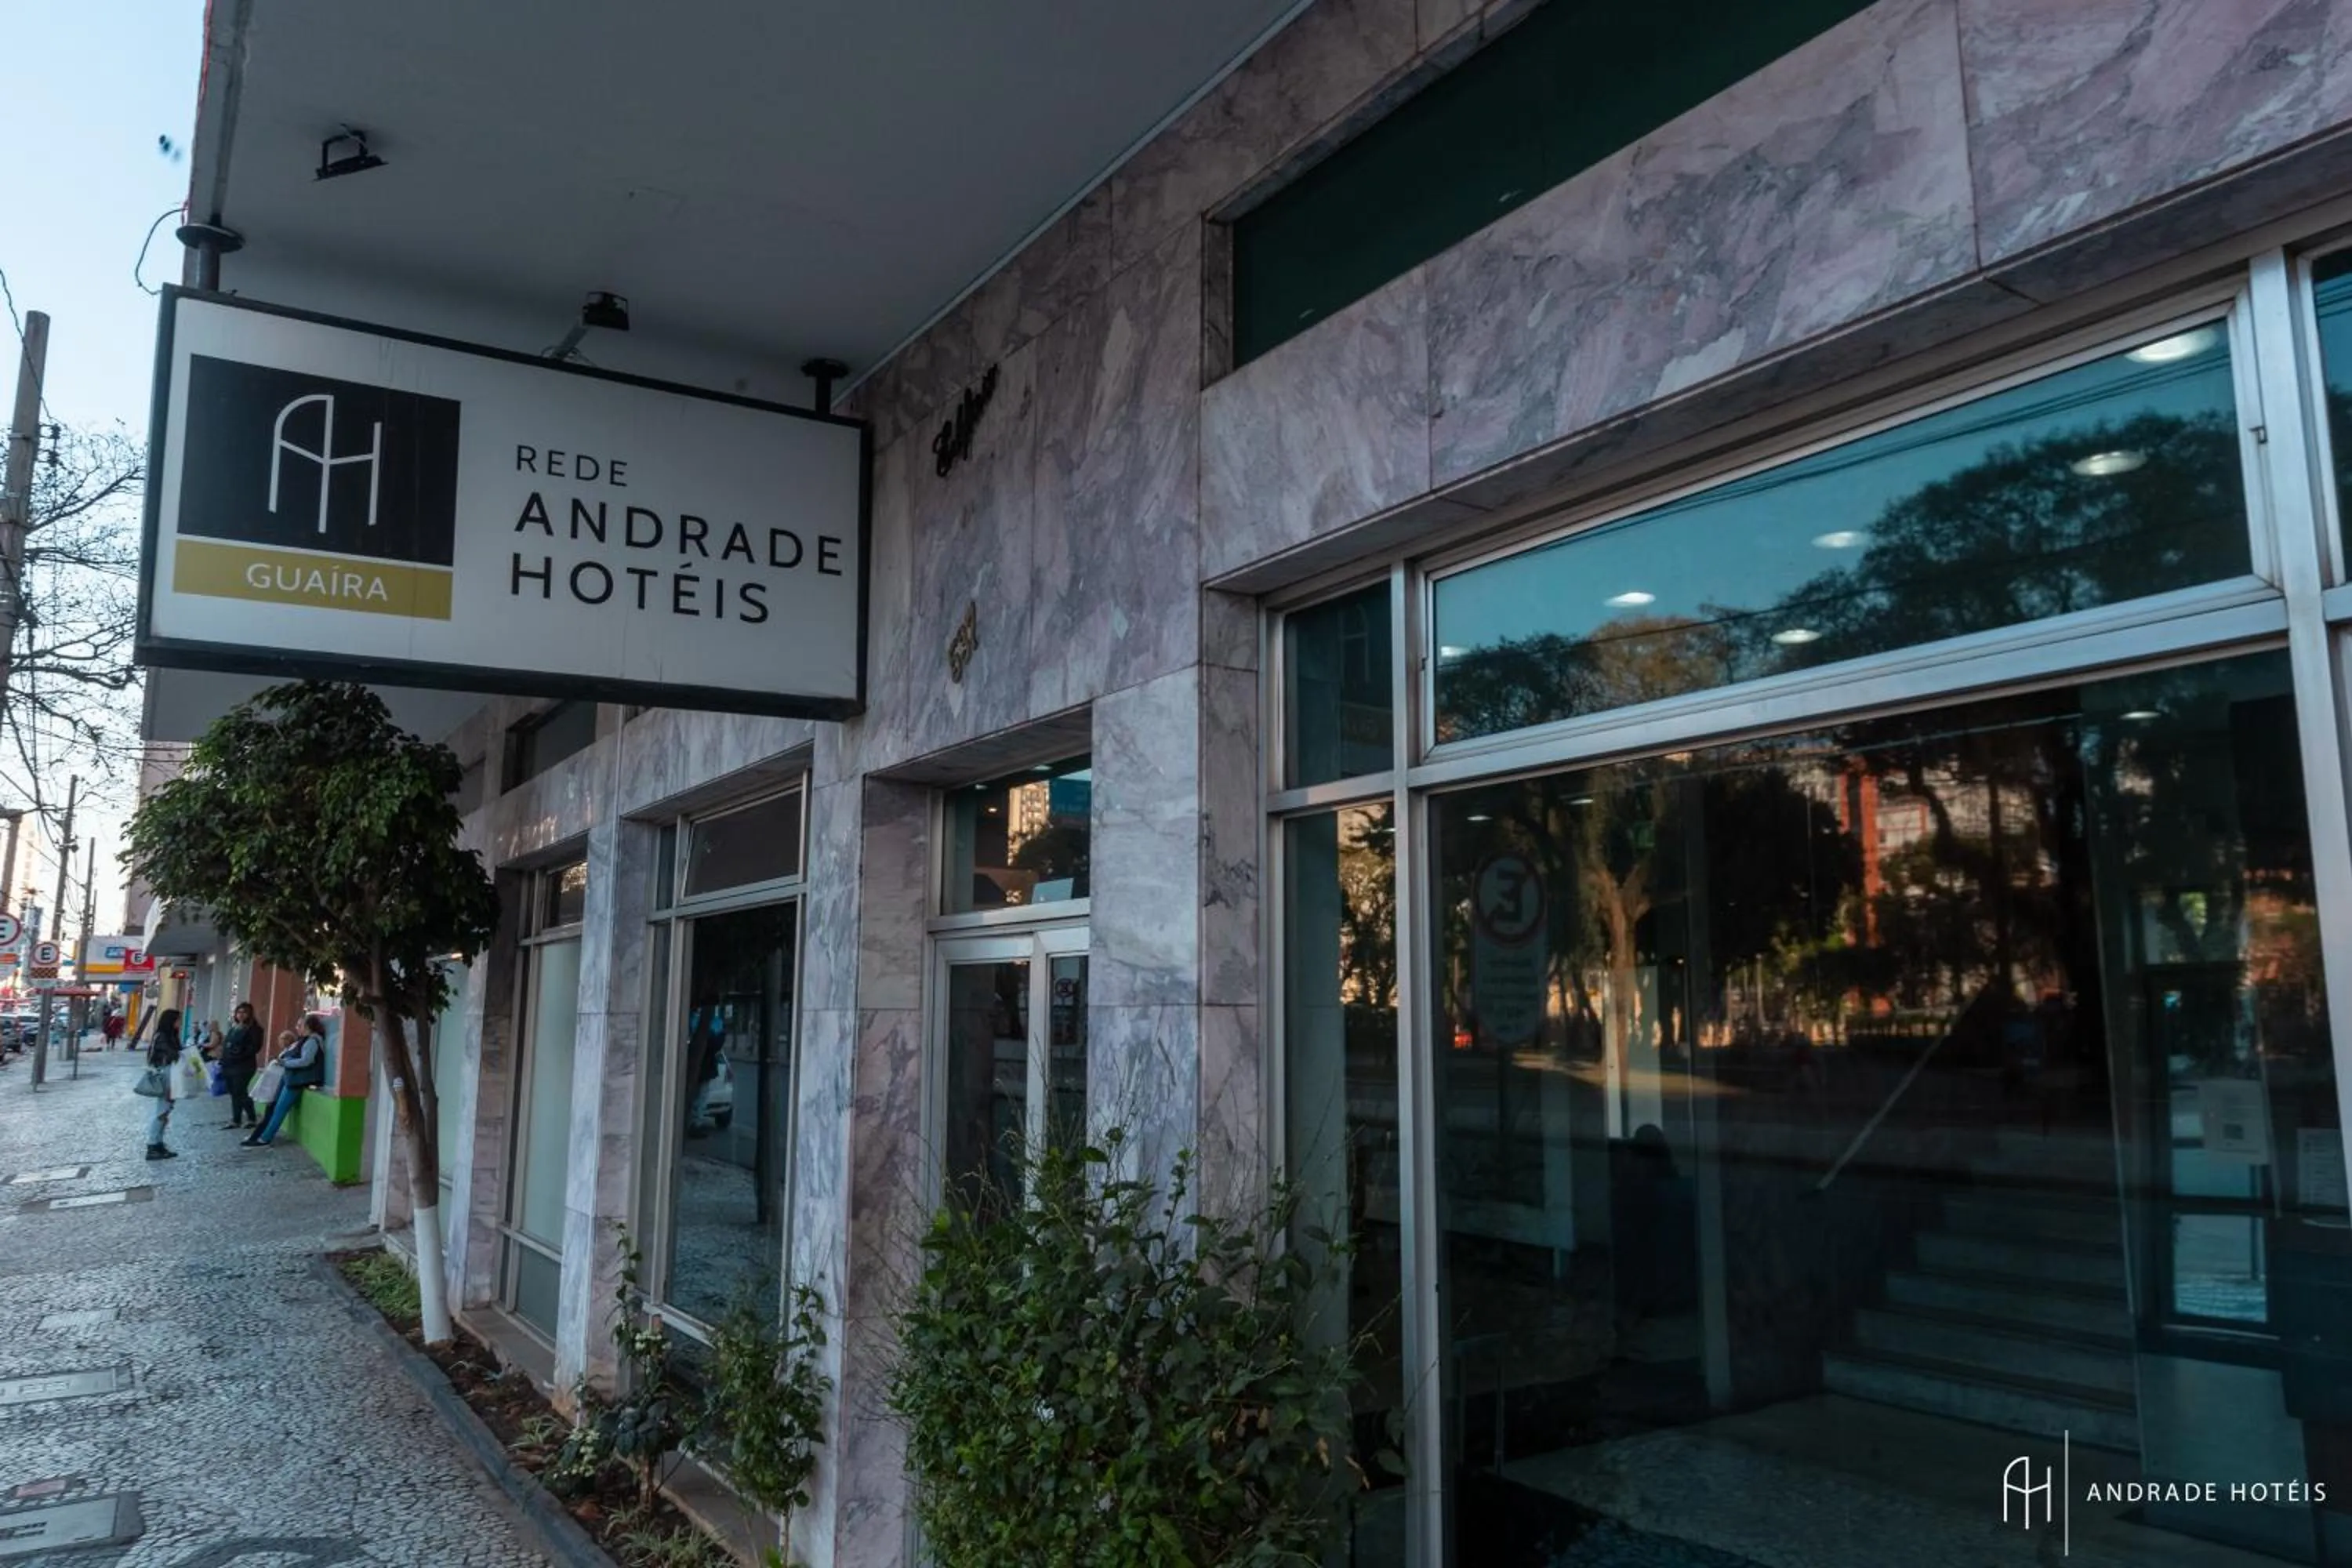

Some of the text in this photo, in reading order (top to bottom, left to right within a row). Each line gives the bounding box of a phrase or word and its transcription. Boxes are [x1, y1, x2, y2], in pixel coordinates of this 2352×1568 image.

[516, 445, 628, 486] REDE
[514, 492, 843, 576] ANDRADE
[247, 563, 388, 601] GUAÍRA
[511, 552, 768, 623] HOTÉIS
[40, 946, 52, 960] E
